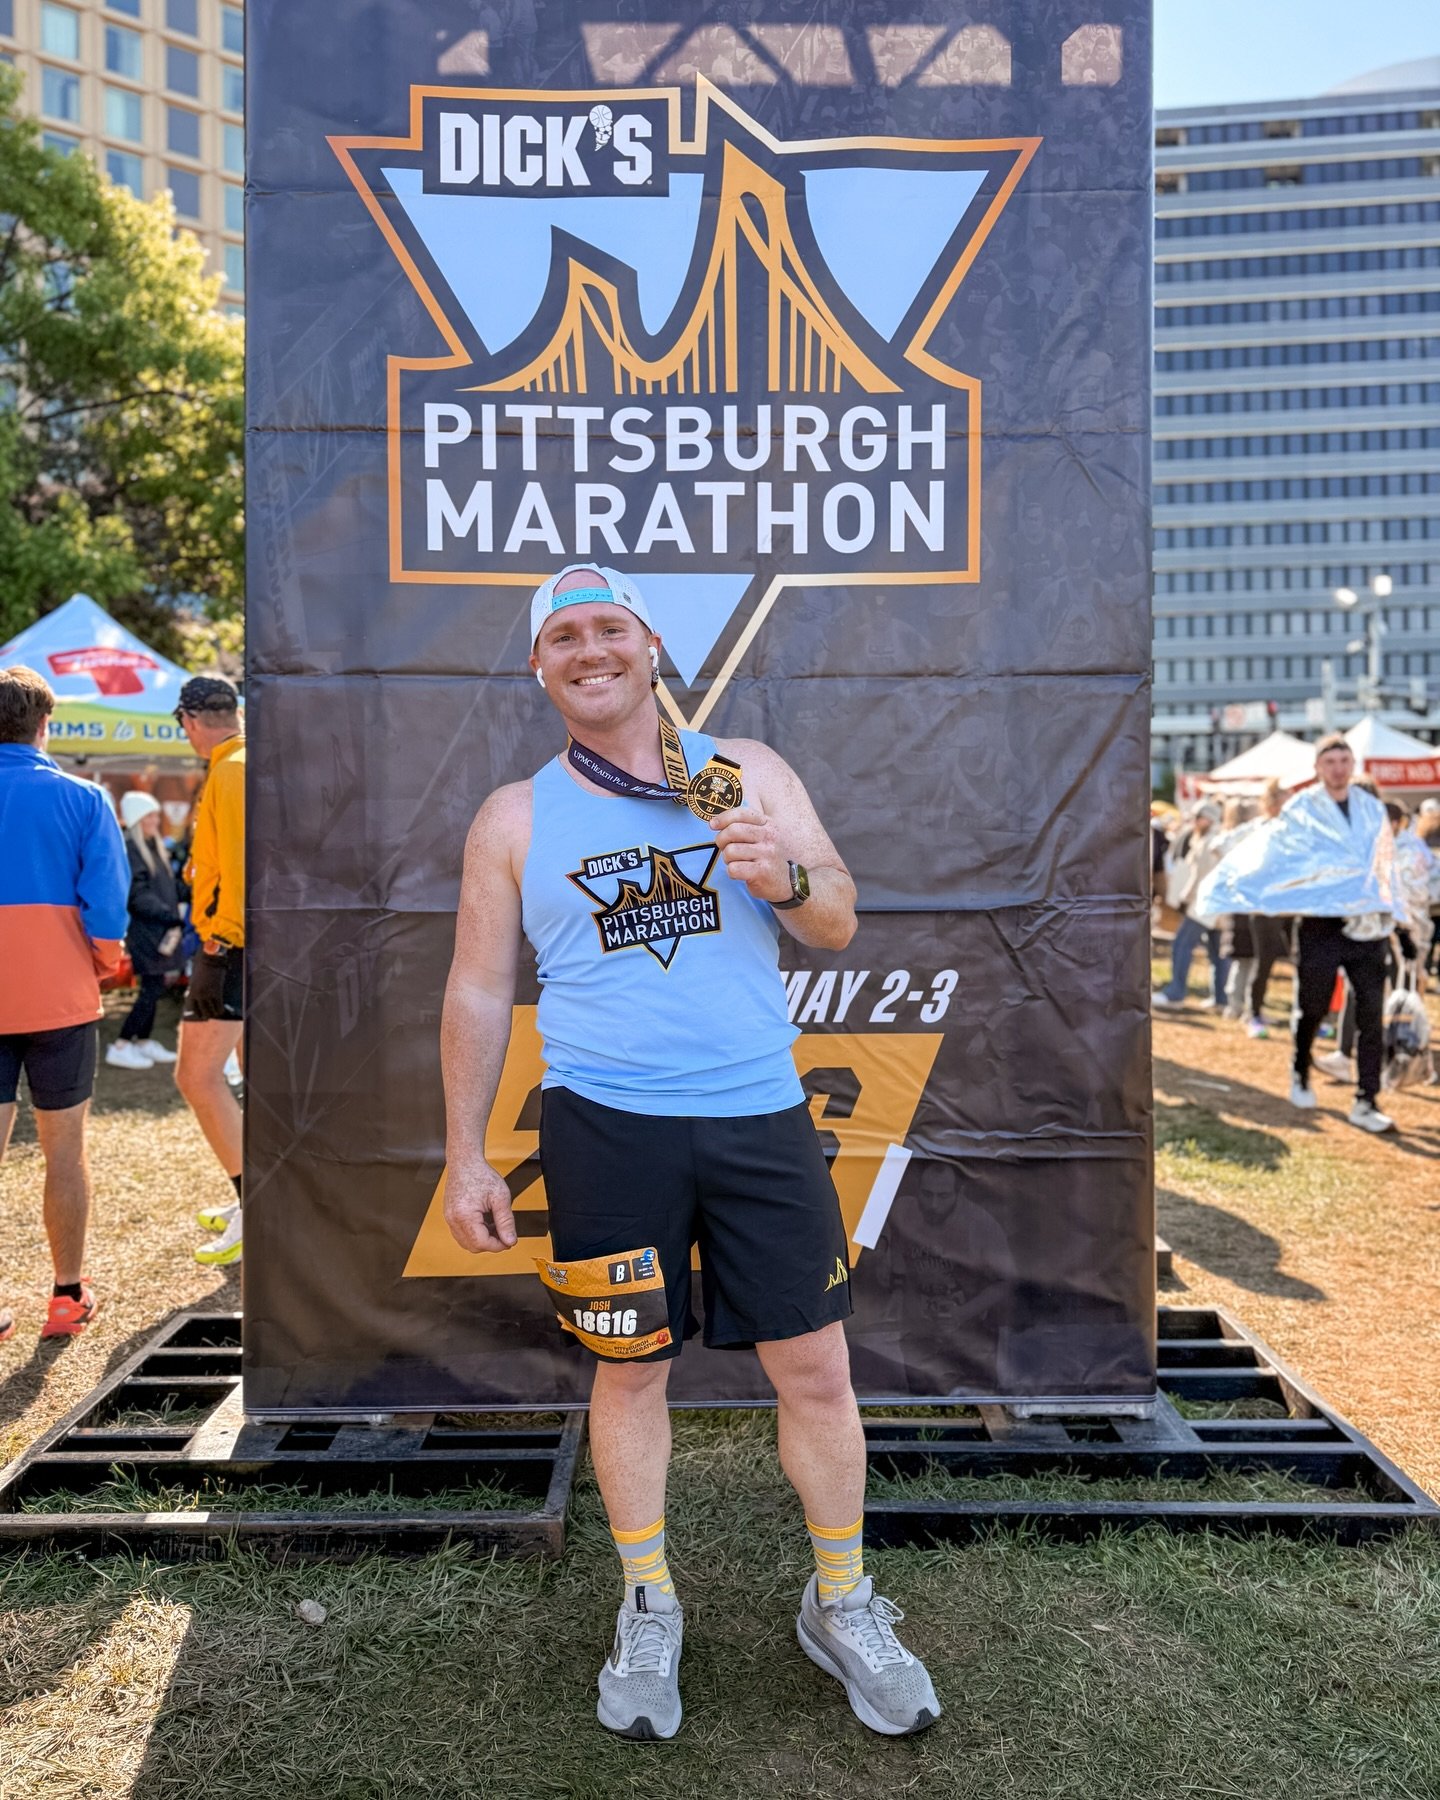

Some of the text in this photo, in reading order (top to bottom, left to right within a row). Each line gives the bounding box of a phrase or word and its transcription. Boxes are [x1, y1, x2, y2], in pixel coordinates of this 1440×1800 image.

[439, 104, 653, 187] DICK'S
[423, 402, 946, 473] PITTSBURGH
[426, 480, 945, 555] MARATHON
[48, 722, 104, 737] RMS
[143, 724, 189, 739] LOC
[573, 749, 593, 767] UPMC
[587, 850, 639, 876] DICK'S
[601, 896, 713, 930] PITTSBURGH
[605, 911, 716, 947] MARATHON
[780, 969, 960, 1024] MAY 2-3
[615, 1264, 625, 1282] B
[588, 1300, 611, 1311] JOSH
[573, 1309, 638, 1336] 18616
